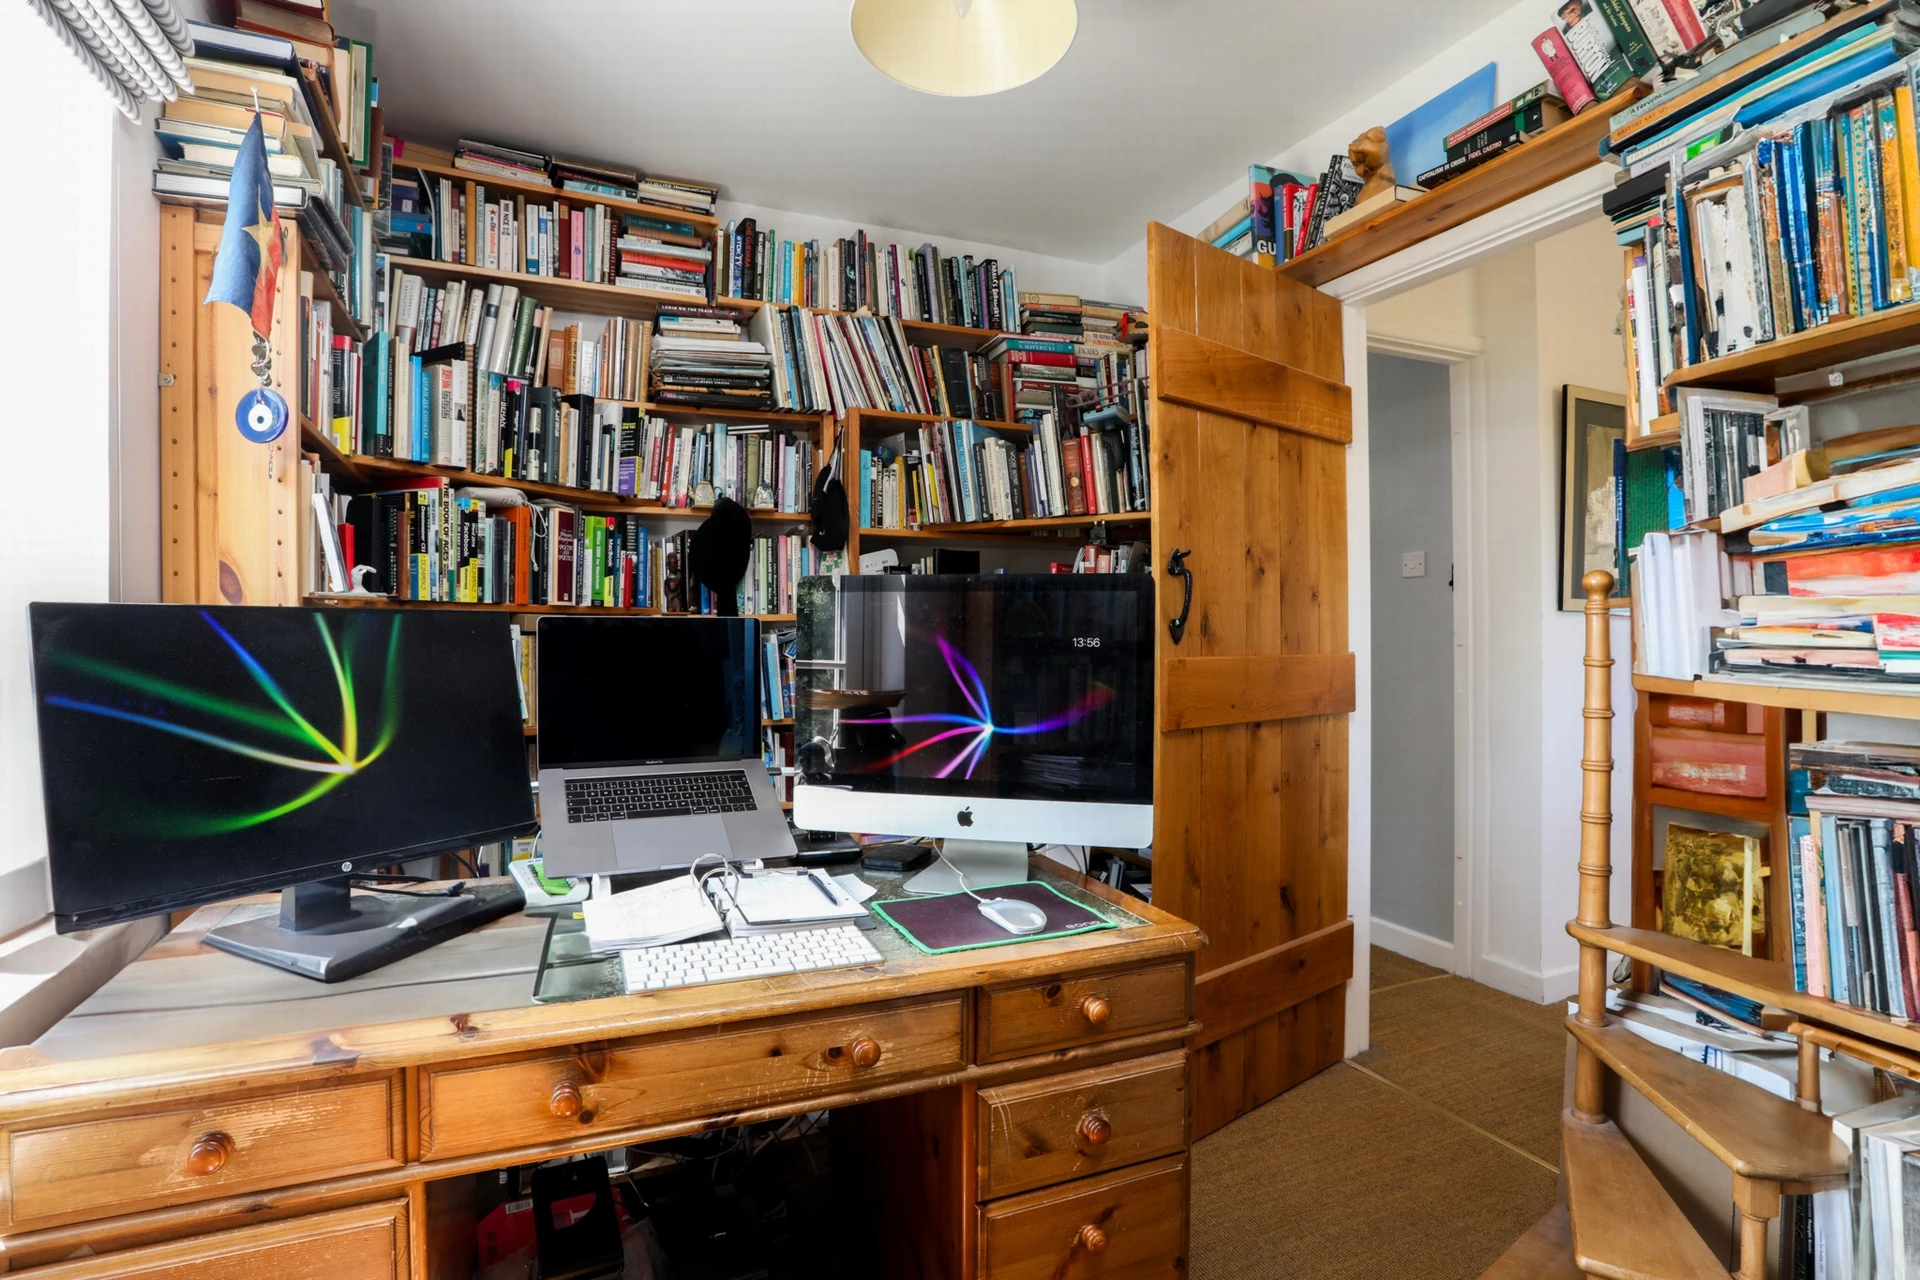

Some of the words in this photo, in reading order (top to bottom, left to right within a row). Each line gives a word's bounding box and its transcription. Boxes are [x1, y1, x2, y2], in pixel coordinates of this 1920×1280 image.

[1566, 30, 1616, 84] BURTON
[1636, 93, 1663, 112] Fervent
[1616, 118, 1642, 136] BRITISH
[1644, 112, 1656, 122] ART
[1418, 166, 1444, 182] CAPITALISM
[1450, 156, 1466, 168] CRISIS
[1468, 149, 1482, 160] FIDEL
[1482, 140, 1502, 154] CASTRO
[1640, 160, 1652, 170] The
[503, 203, 510, 212] MR
[735, 255, 742, 266] TV
[992, 288, 1000, 318] BUKOWSKI
[443, 526, 449, 538] OF
[1072, 638, 1100, 648] 13:56
